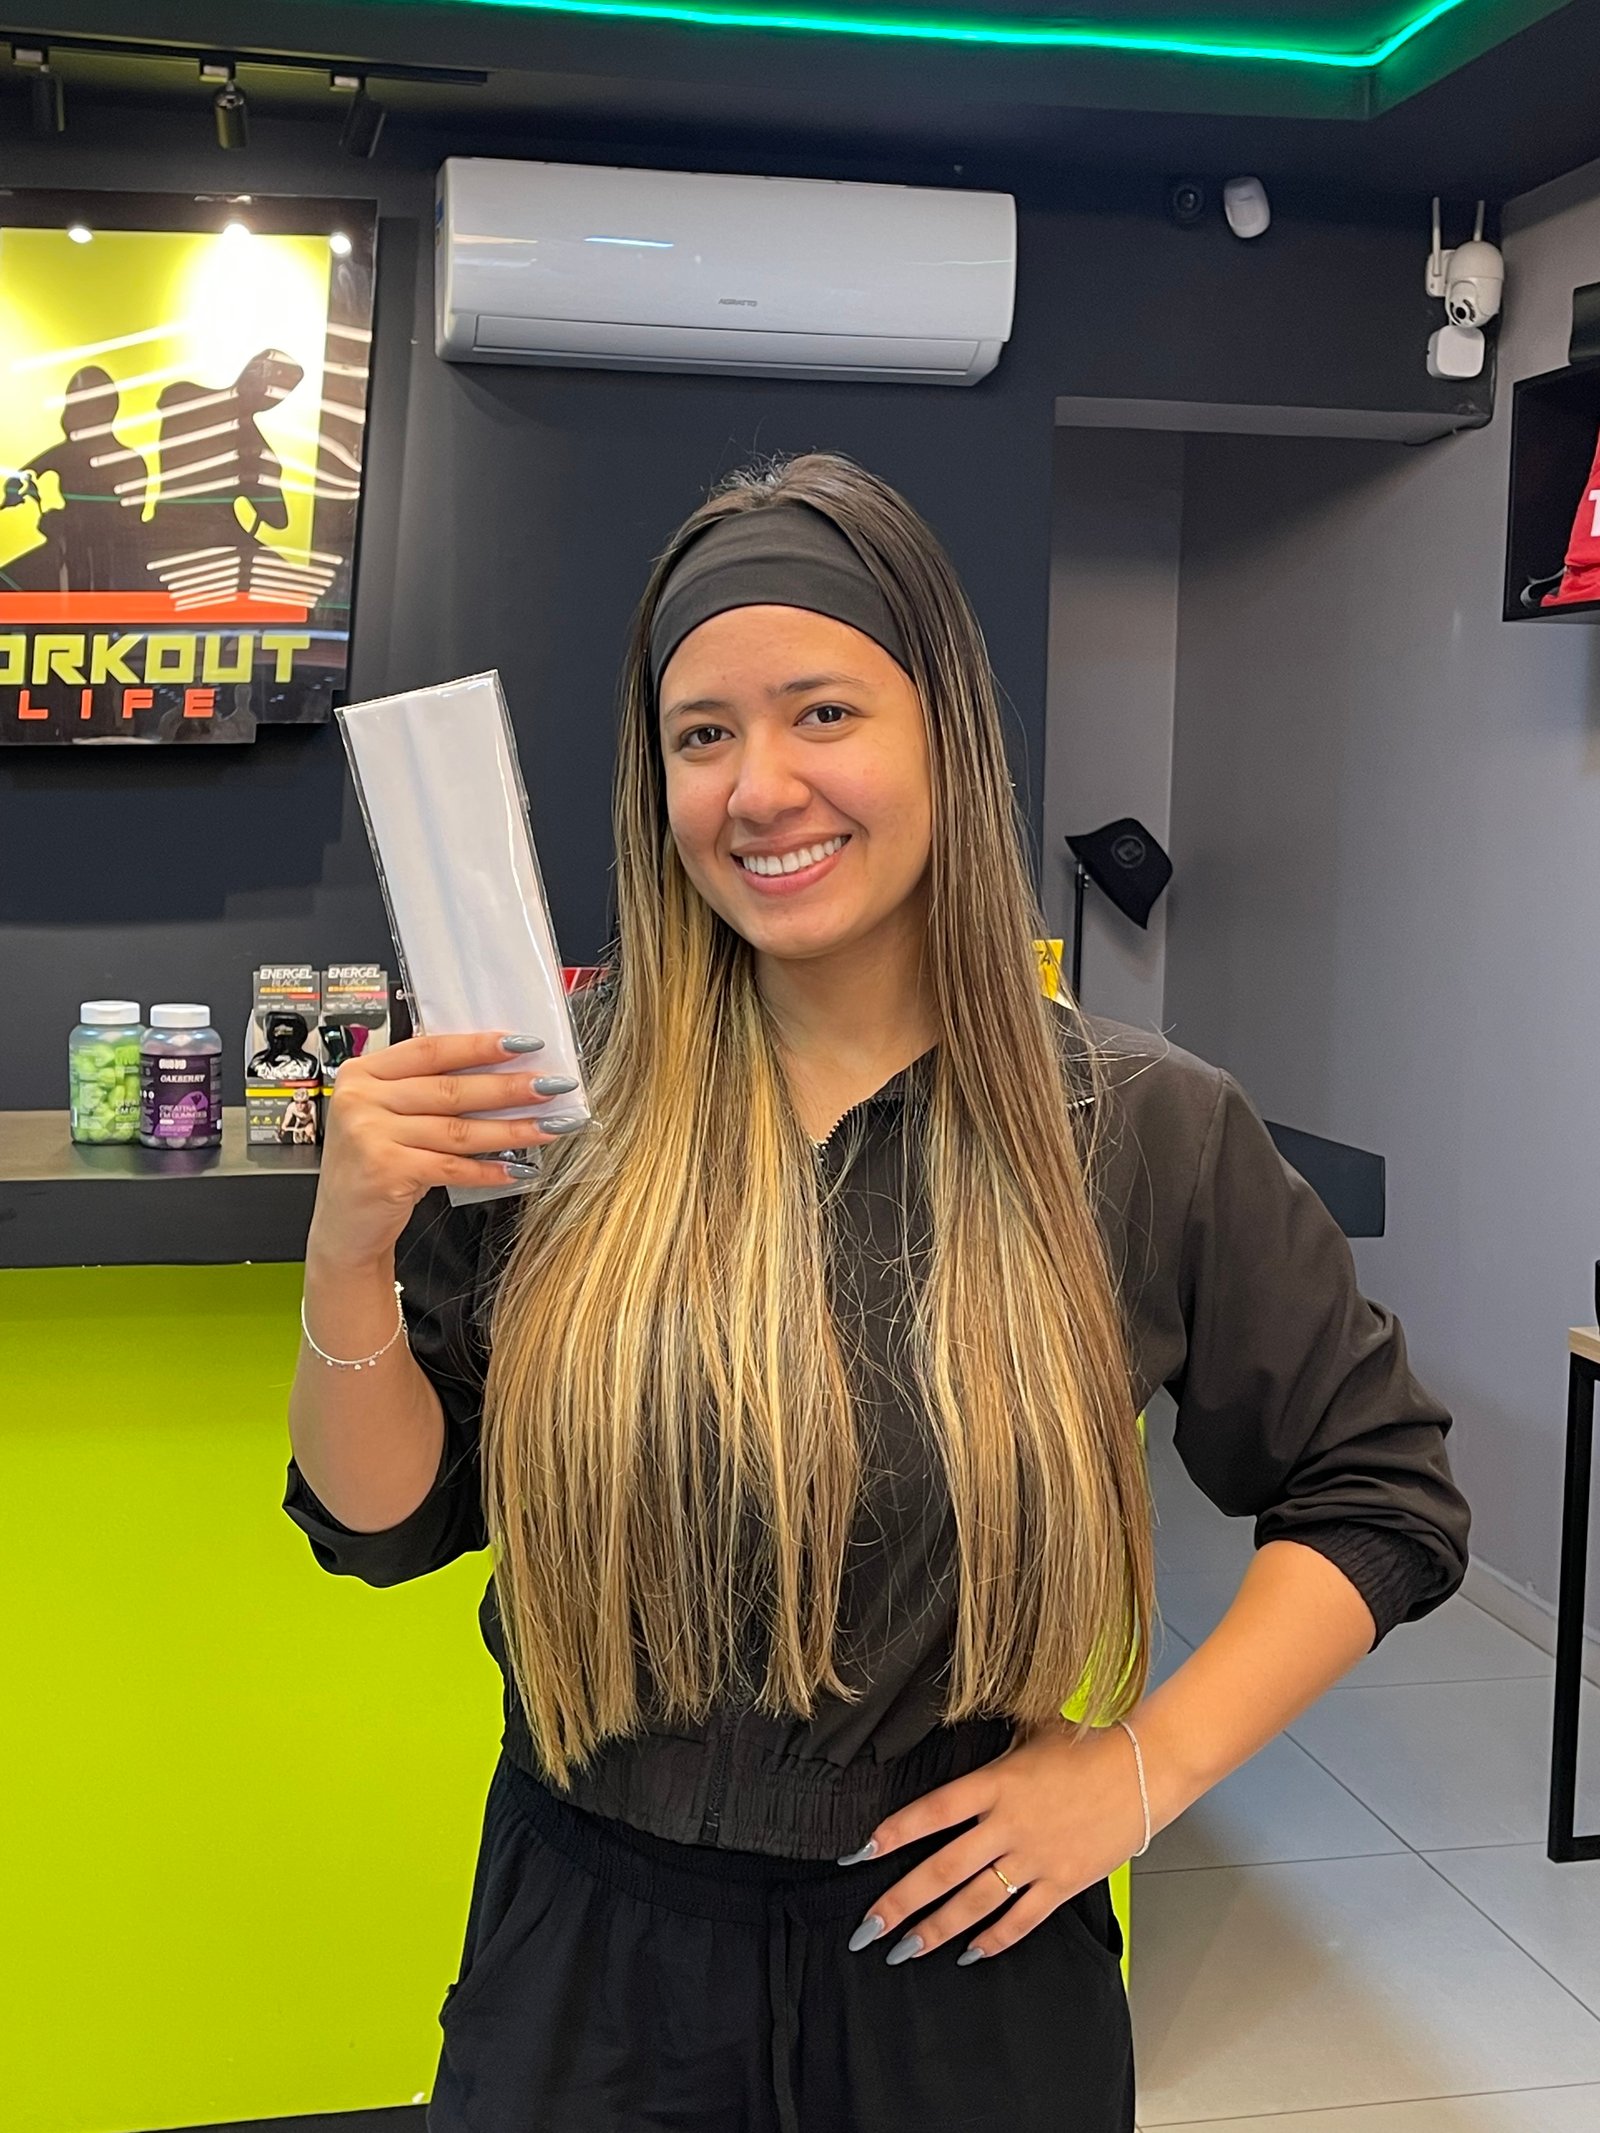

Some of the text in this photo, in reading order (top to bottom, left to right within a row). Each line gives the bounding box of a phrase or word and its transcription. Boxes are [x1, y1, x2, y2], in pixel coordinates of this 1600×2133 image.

[18, 688, 216, 720] LIFE
[260, 968, 312, 979] ENERGEL
[328, 967, 380, 978] ENERGEL
